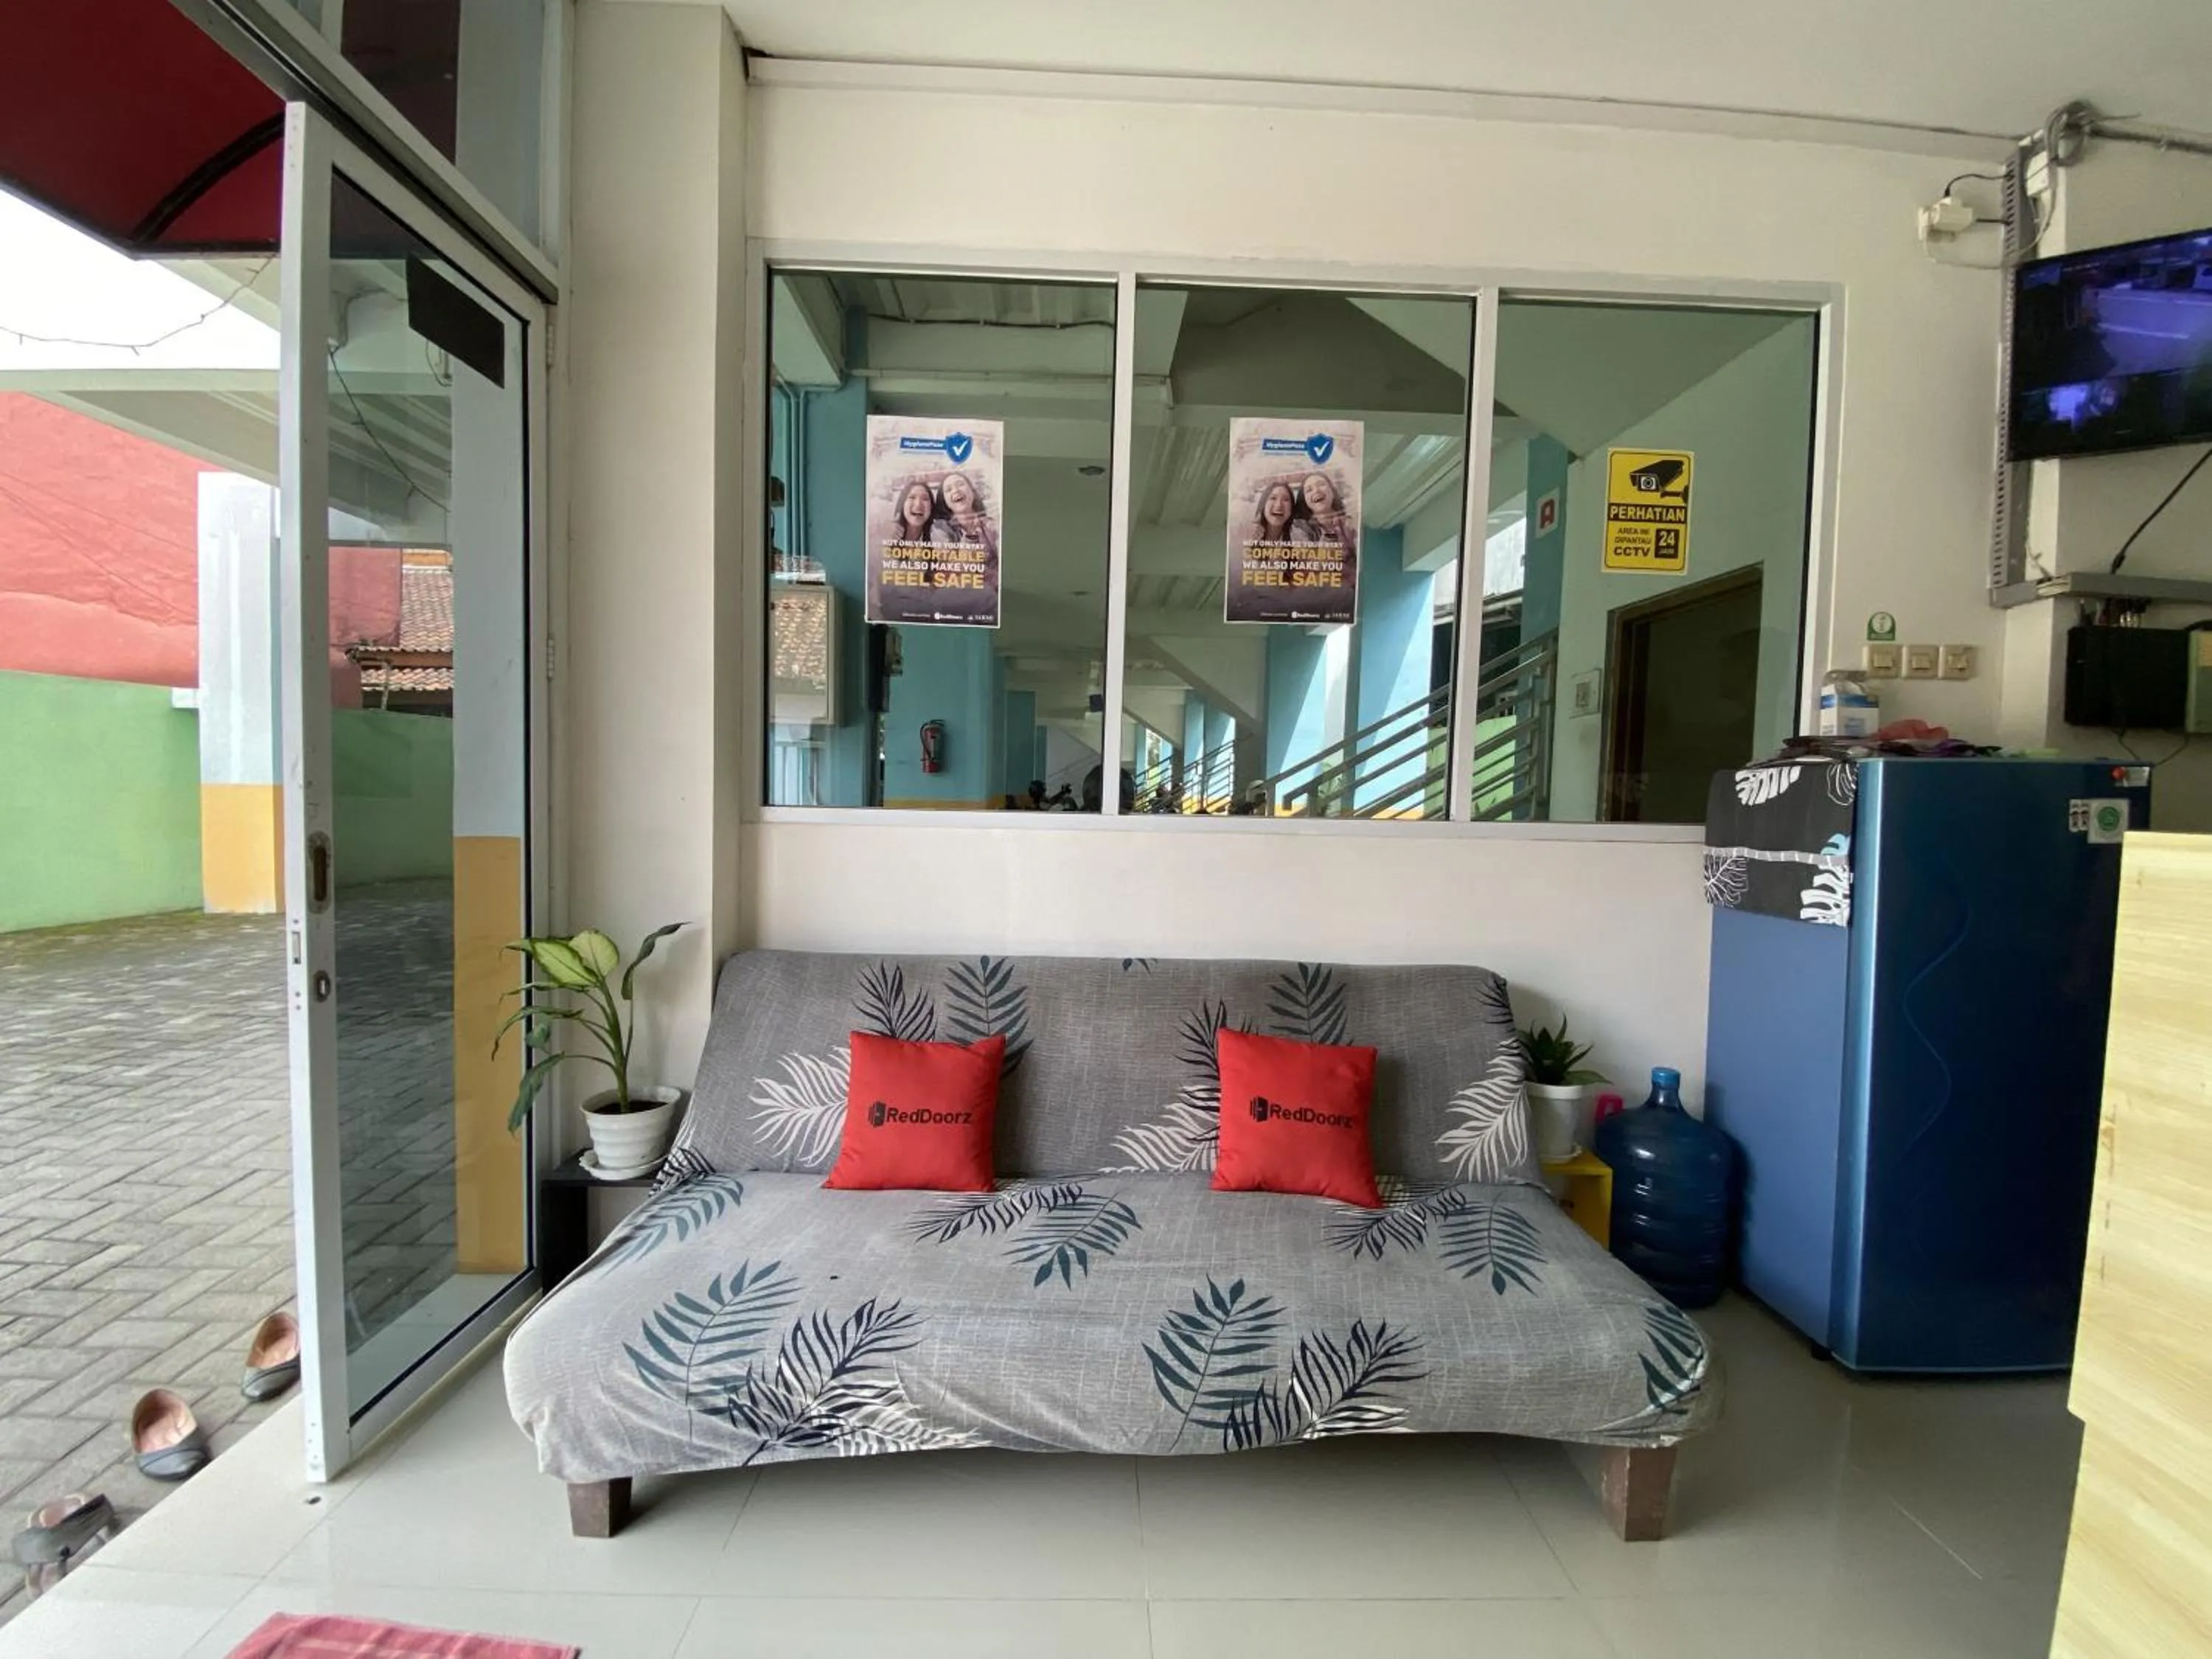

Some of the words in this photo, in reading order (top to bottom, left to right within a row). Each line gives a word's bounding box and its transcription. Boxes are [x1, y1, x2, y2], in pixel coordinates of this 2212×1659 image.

[1610, 505, 1686, 522] PERHATIAN
[1617, 527, 1638, 535] AREA
[1658, 531, 1675, 546] 24
[1615, 536, 1652, 544] DIPANTAU
[883, 546, 984, 562] COMFORTABLE
[1242, 547, 1343, 560] COMFORTABLE
[1614, 546, 1650, 557] CCTV
[883, 560, 898, 568] WE
[900, 561, 928, 570] ALSO
[931, 562, 962, 571] MAKE
[962, 563, 984, 572] YOU
[1242, 560, 1258, 569] WE
[1260, 560, 1287, 570] ALSO
[1290, 561, 1319, 571] MAKE
[1321, 562, 1343, 571] YOU
[882, 570, 929, 587] FEEL
[933, 571, 984, 589] SAFE
[1242, 570, 1289, 586] FEEL
[1293, 571, 1343, 588] SAFE
[886, 1107, 973, 1124] RedDoorz
[1270, 1103, 1354, 1129] RedDoorz
